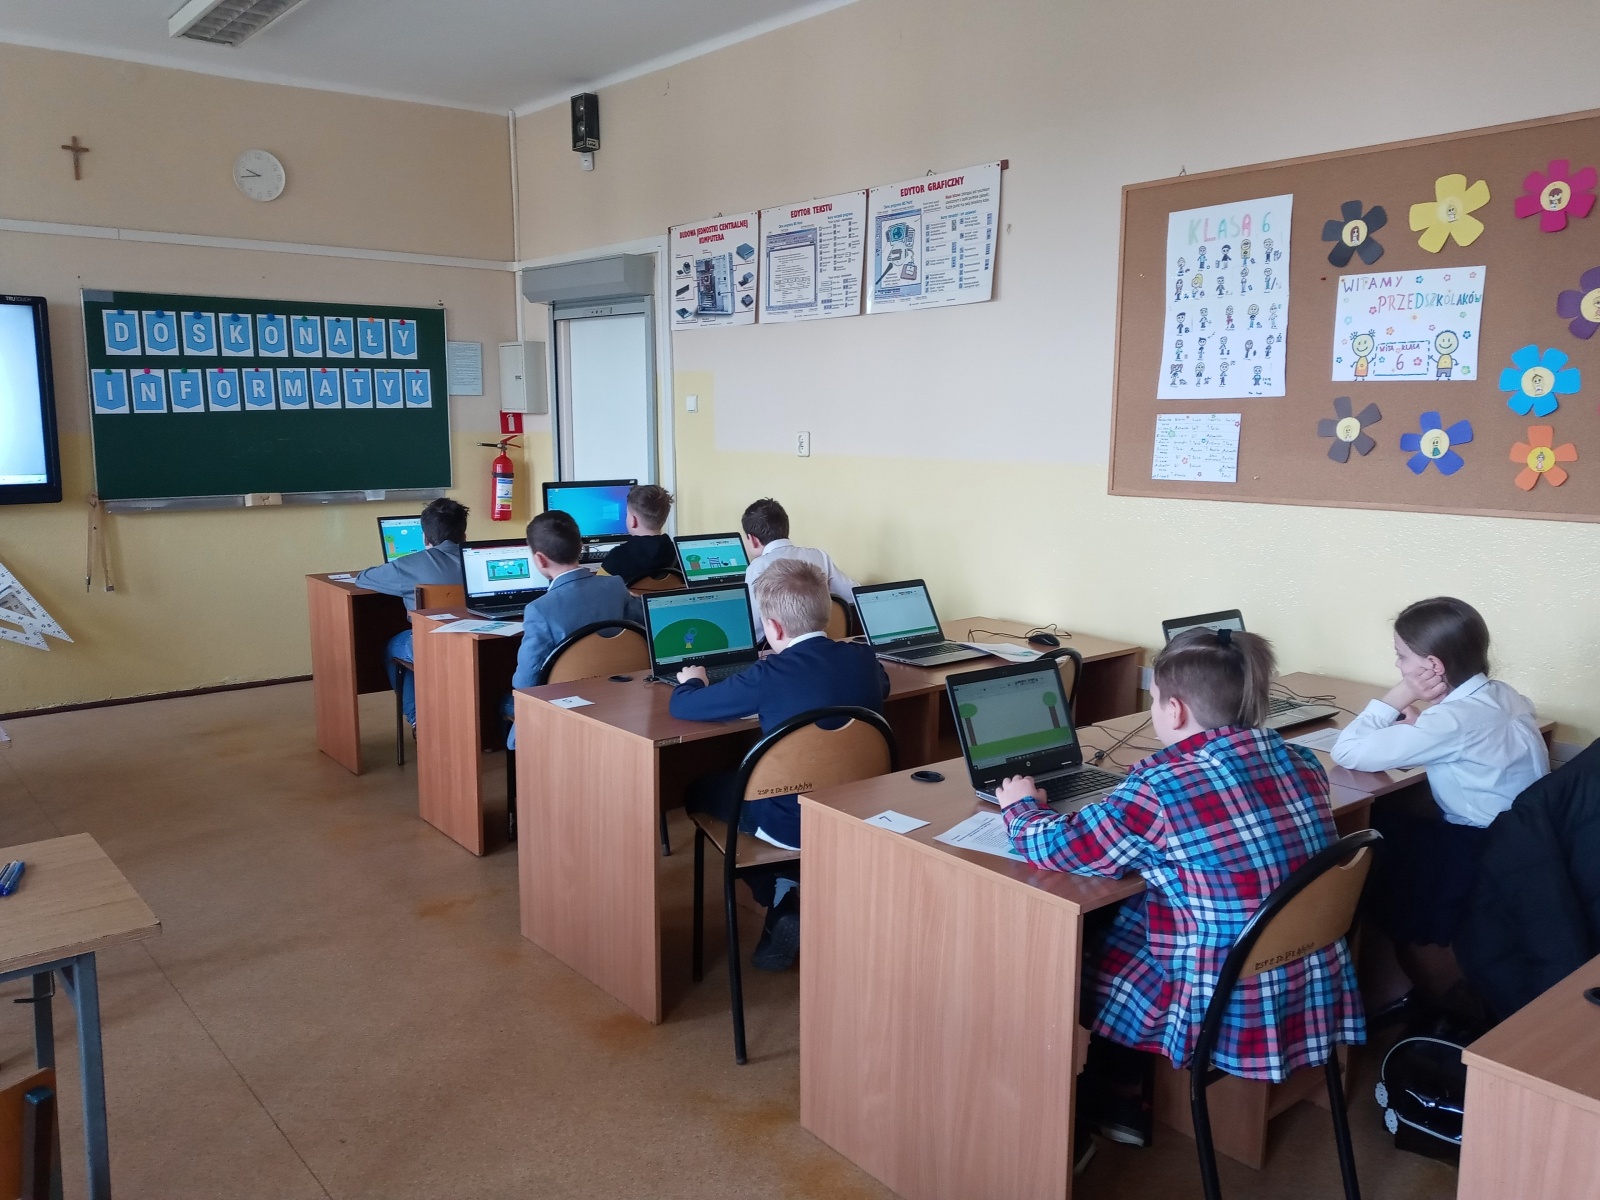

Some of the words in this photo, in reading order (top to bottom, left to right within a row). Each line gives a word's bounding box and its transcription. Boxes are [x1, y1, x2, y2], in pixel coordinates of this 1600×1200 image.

[900, 184, 925, 197] EDYTOR
[927, 176, 965, 192] GRAFICZNY
[790, 208, 811, 218] EDYTOR
[812, 203, 833, 214] TEKSTU
[679, 229, 697, 239] BUDOWA
[718, 219, 749, 231] CENTRALNEJ
[1188, 213, 1252, 245] KLASA
[1262, 211, 1271, 232] 6
[698, 233, 725, 244] KOMPUTERA
[1343, 276, 1404, 293] WITAMY
[114, 322, 410, 347] DOSKONAŁY
[1396, 353, 1404, 370] 6
[106, 379, 424, 402] INFORMATYK
